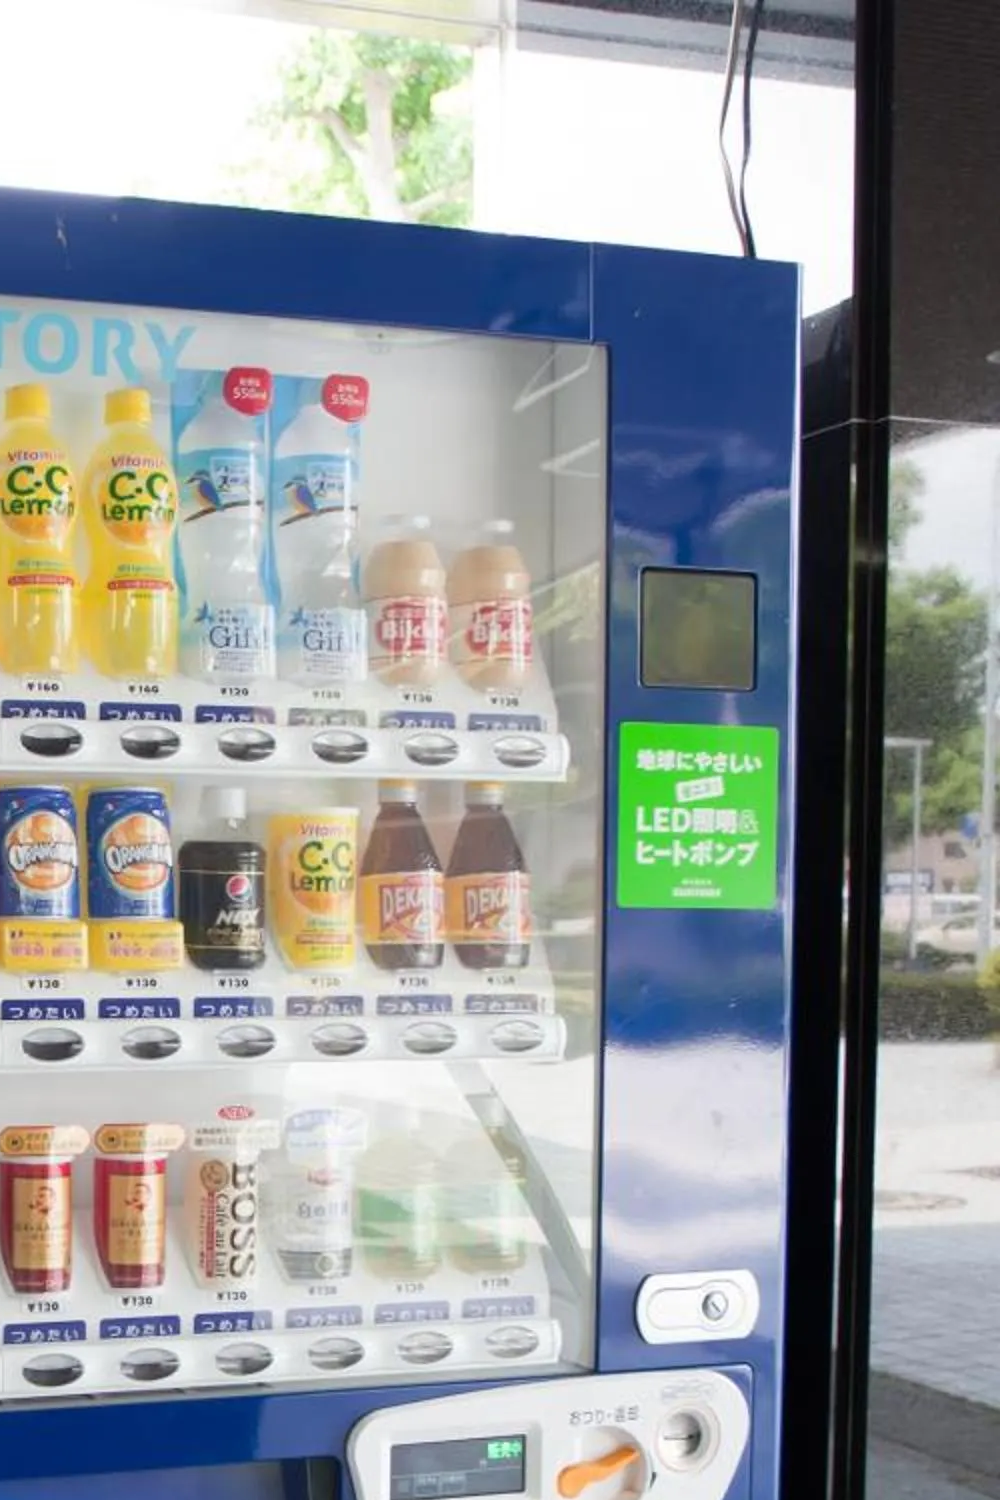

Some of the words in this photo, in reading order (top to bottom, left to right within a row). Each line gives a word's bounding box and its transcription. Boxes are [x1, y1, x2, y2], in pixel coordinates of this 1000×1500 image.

[636, 748, 763, 773] 地球にやさしい
[636, 839, 760, 866] ヒートポンプ
[10, 1007, 77, 1019] つめたい
[106, 1005, 173, 1018] つめたい
[201, 1004, 267, 1017] つめたい
[230, 1162, 257, 1278] BOSS
[107, 1323, 174, 1337] つめたい
[201, 1318, 266, 1332] つめたい
[11, 1328, 79, 1342] つめたい
